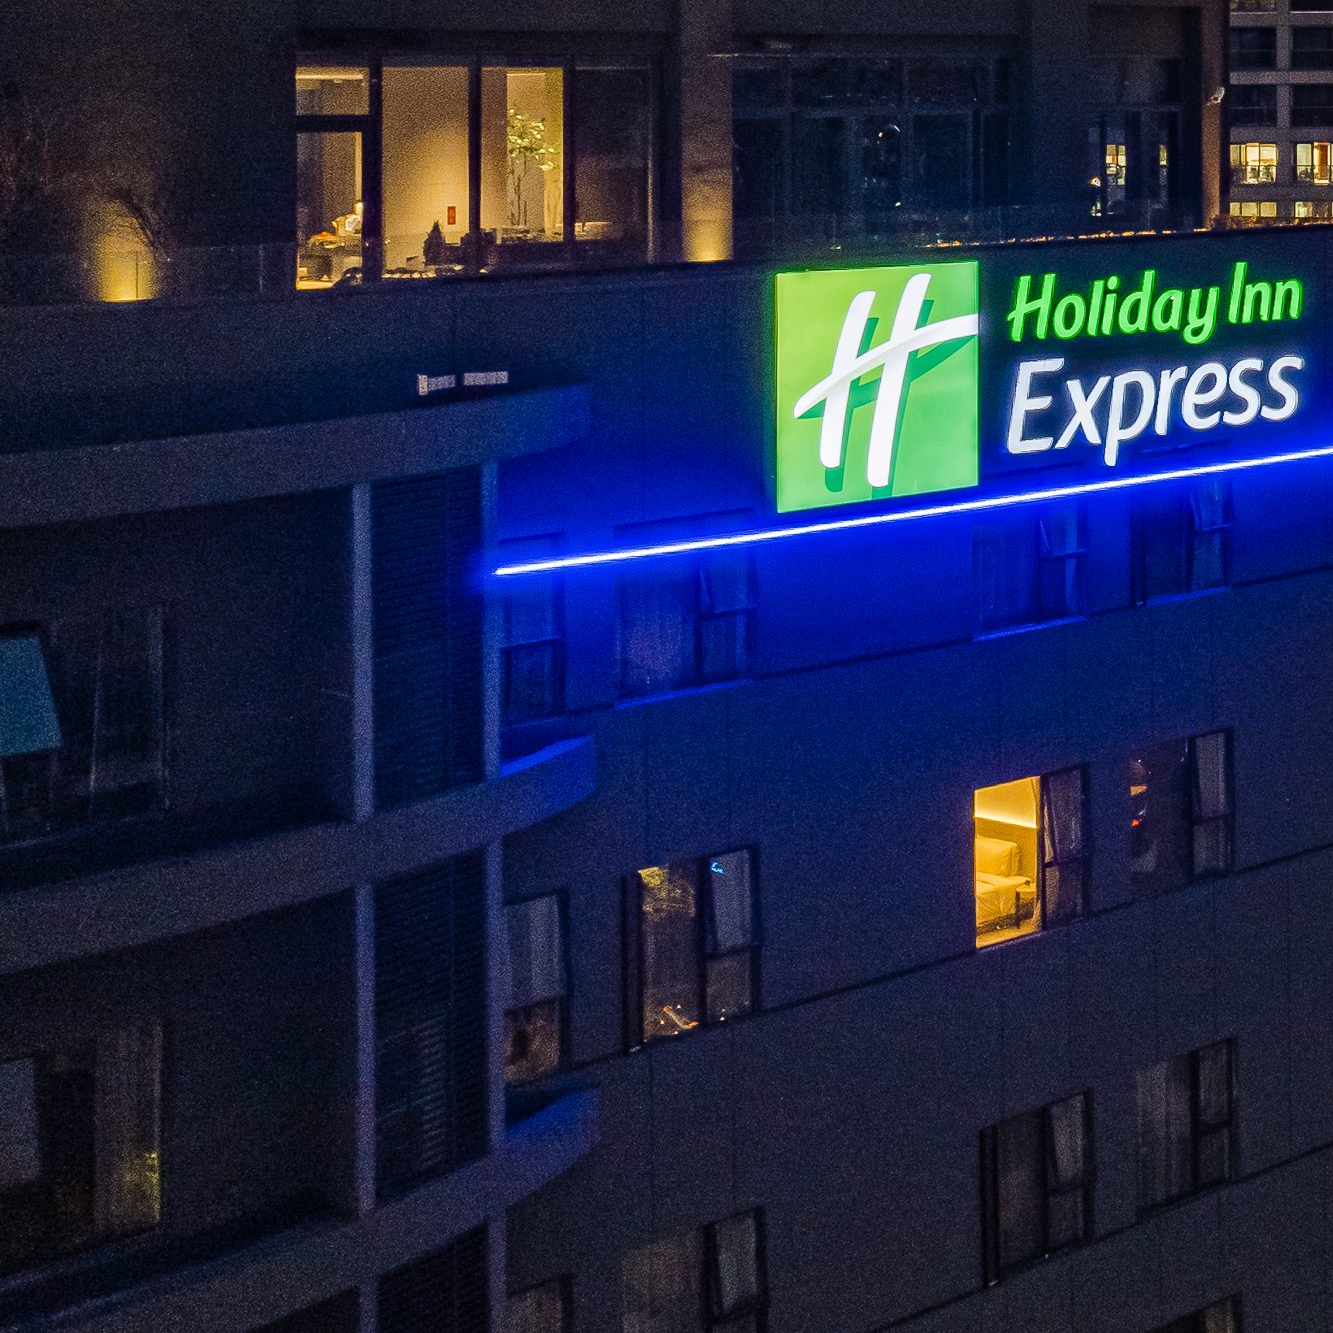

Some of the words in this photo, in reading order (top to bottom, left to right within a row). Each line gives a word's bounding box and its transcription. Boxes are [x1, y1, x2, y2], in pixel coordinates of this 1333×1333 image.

[1006, 268, 1219, 344] Holiday
[1228, 261, 1303, 324] Inn
[1006, 355, 1304, 468] Express
